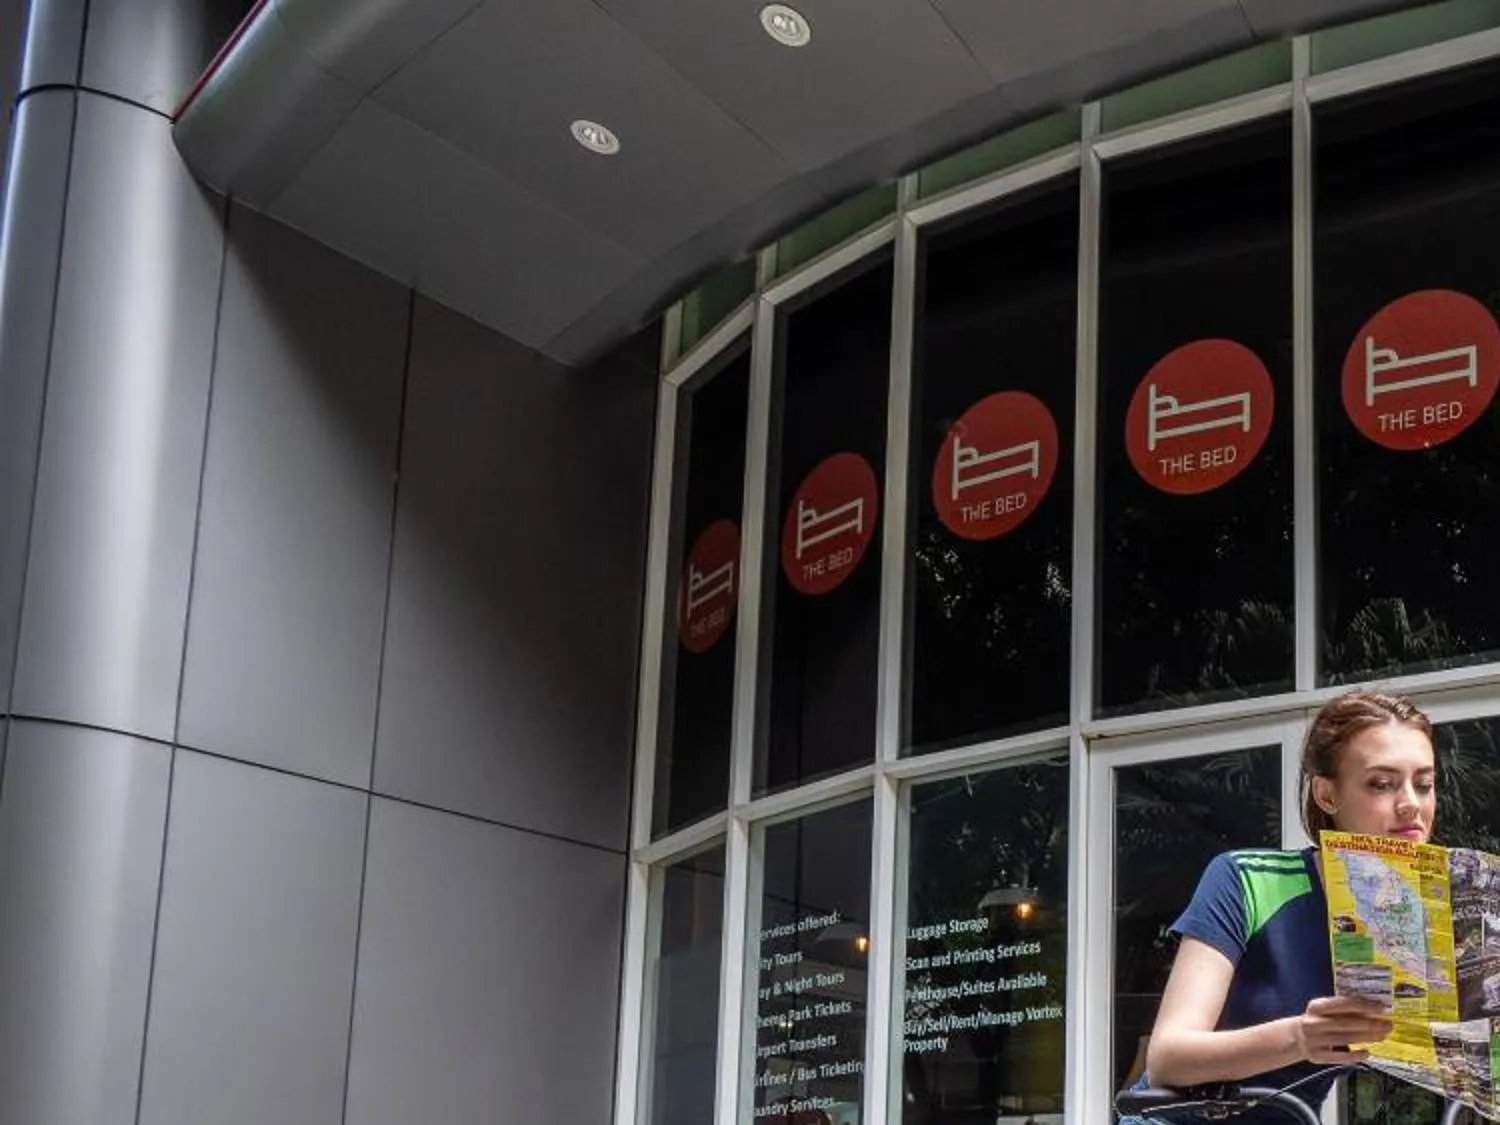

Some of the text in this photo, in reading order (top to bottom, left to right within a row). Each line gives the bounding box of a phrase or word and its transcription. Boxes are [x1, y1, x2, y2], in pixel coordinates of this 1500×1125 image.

[1377, 401, 1463, 432] THE BED
[1159, 445, 1237, 476] THE BED
[961, 492, 1027, 523] THE BED
[798, 908, 841, 931] offered:
[906, 917, 989, 940] Luggage Storage
[774, 951, 803, 965] Tours
[905, 941, 1041, 971] Scan and Printing Services
[785, 977, 813, 994] Night
[815, 972, 845, 988] Tours
[997, 971, 1047, 991] Available
[788, 1005, 812, 1022] Park
[814, 1001, 852, 1017] Tickets
[1026, 1005, 1064, 1021] Vortex
[788, 1034, 837, 1052] Transfers
[903, 1036, 948, 1055] Property
[797, 1067, 817, 1081] Bus
[790, 1096, 835, 1113] Services
